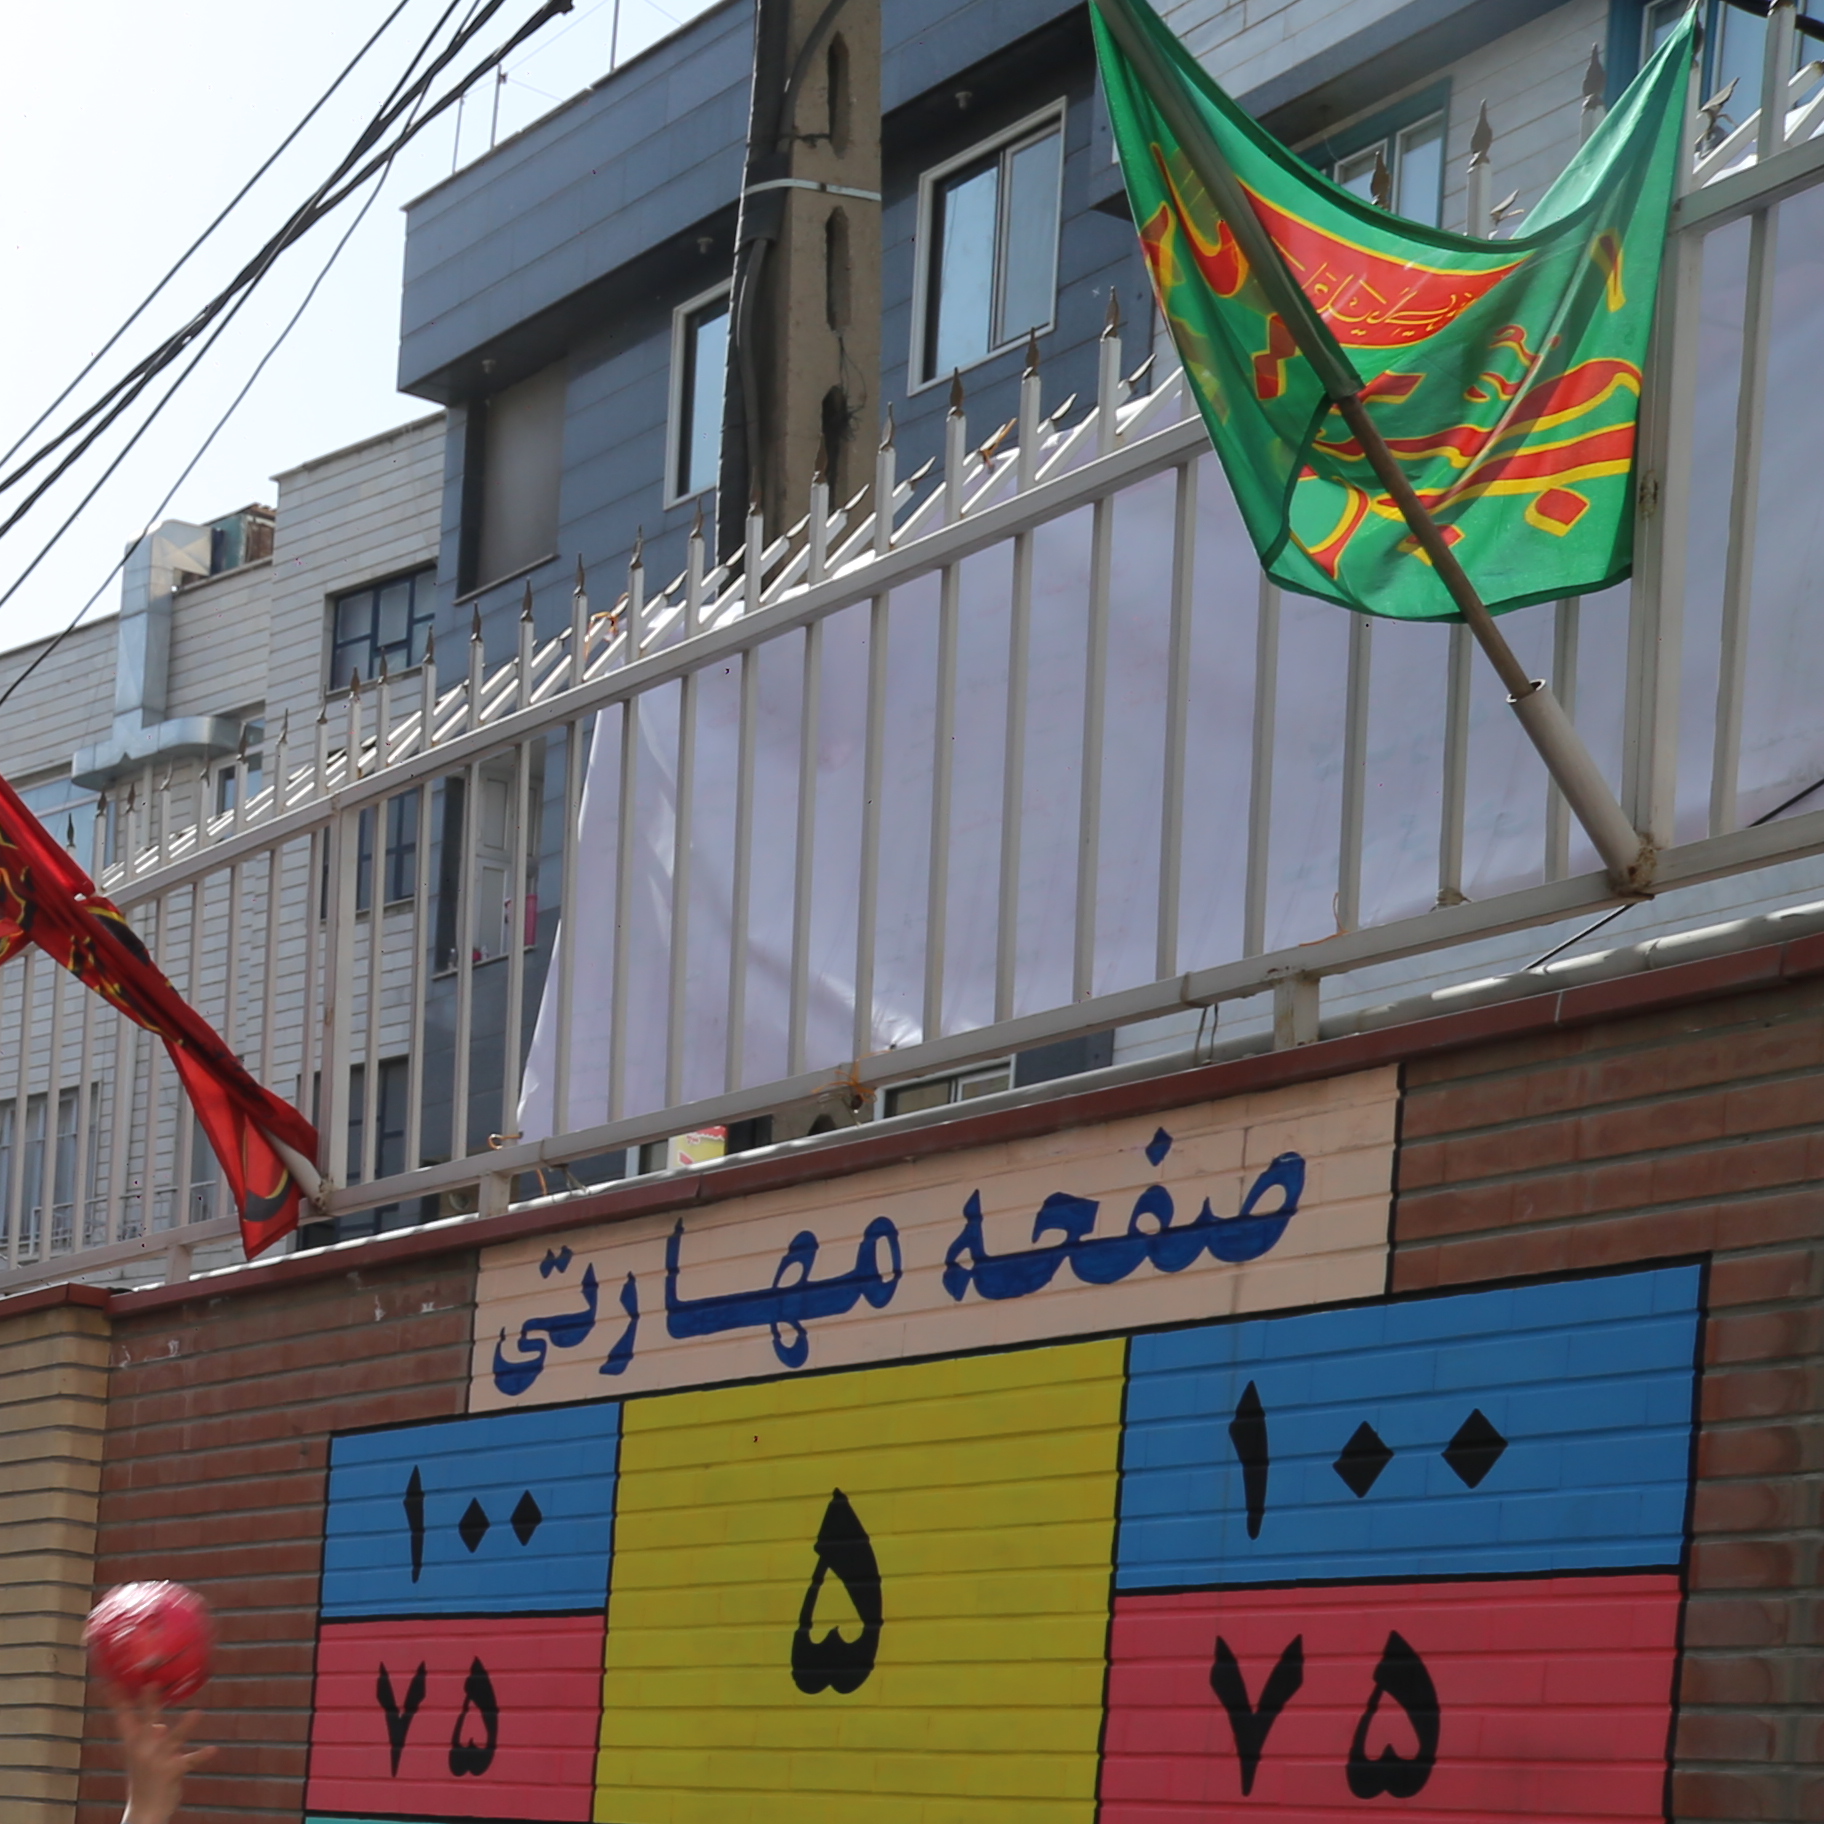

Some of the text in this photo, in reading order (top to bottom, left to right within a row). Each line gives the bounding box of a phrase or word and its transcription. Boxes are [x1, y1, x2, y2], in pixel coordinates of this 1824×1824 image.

[491, 1127, 1308, 1397] صفحه مهارتی
[404, 1466, 542, 1583] ۱۰۰
[1229, 1381, 1512, 1540] ۱۰۰
[792, 1488, 883, 1694] ۵
[377, 1657, 500, 1777] ۷۵
[1210, 1630, 1440, 1799] ۷۵
